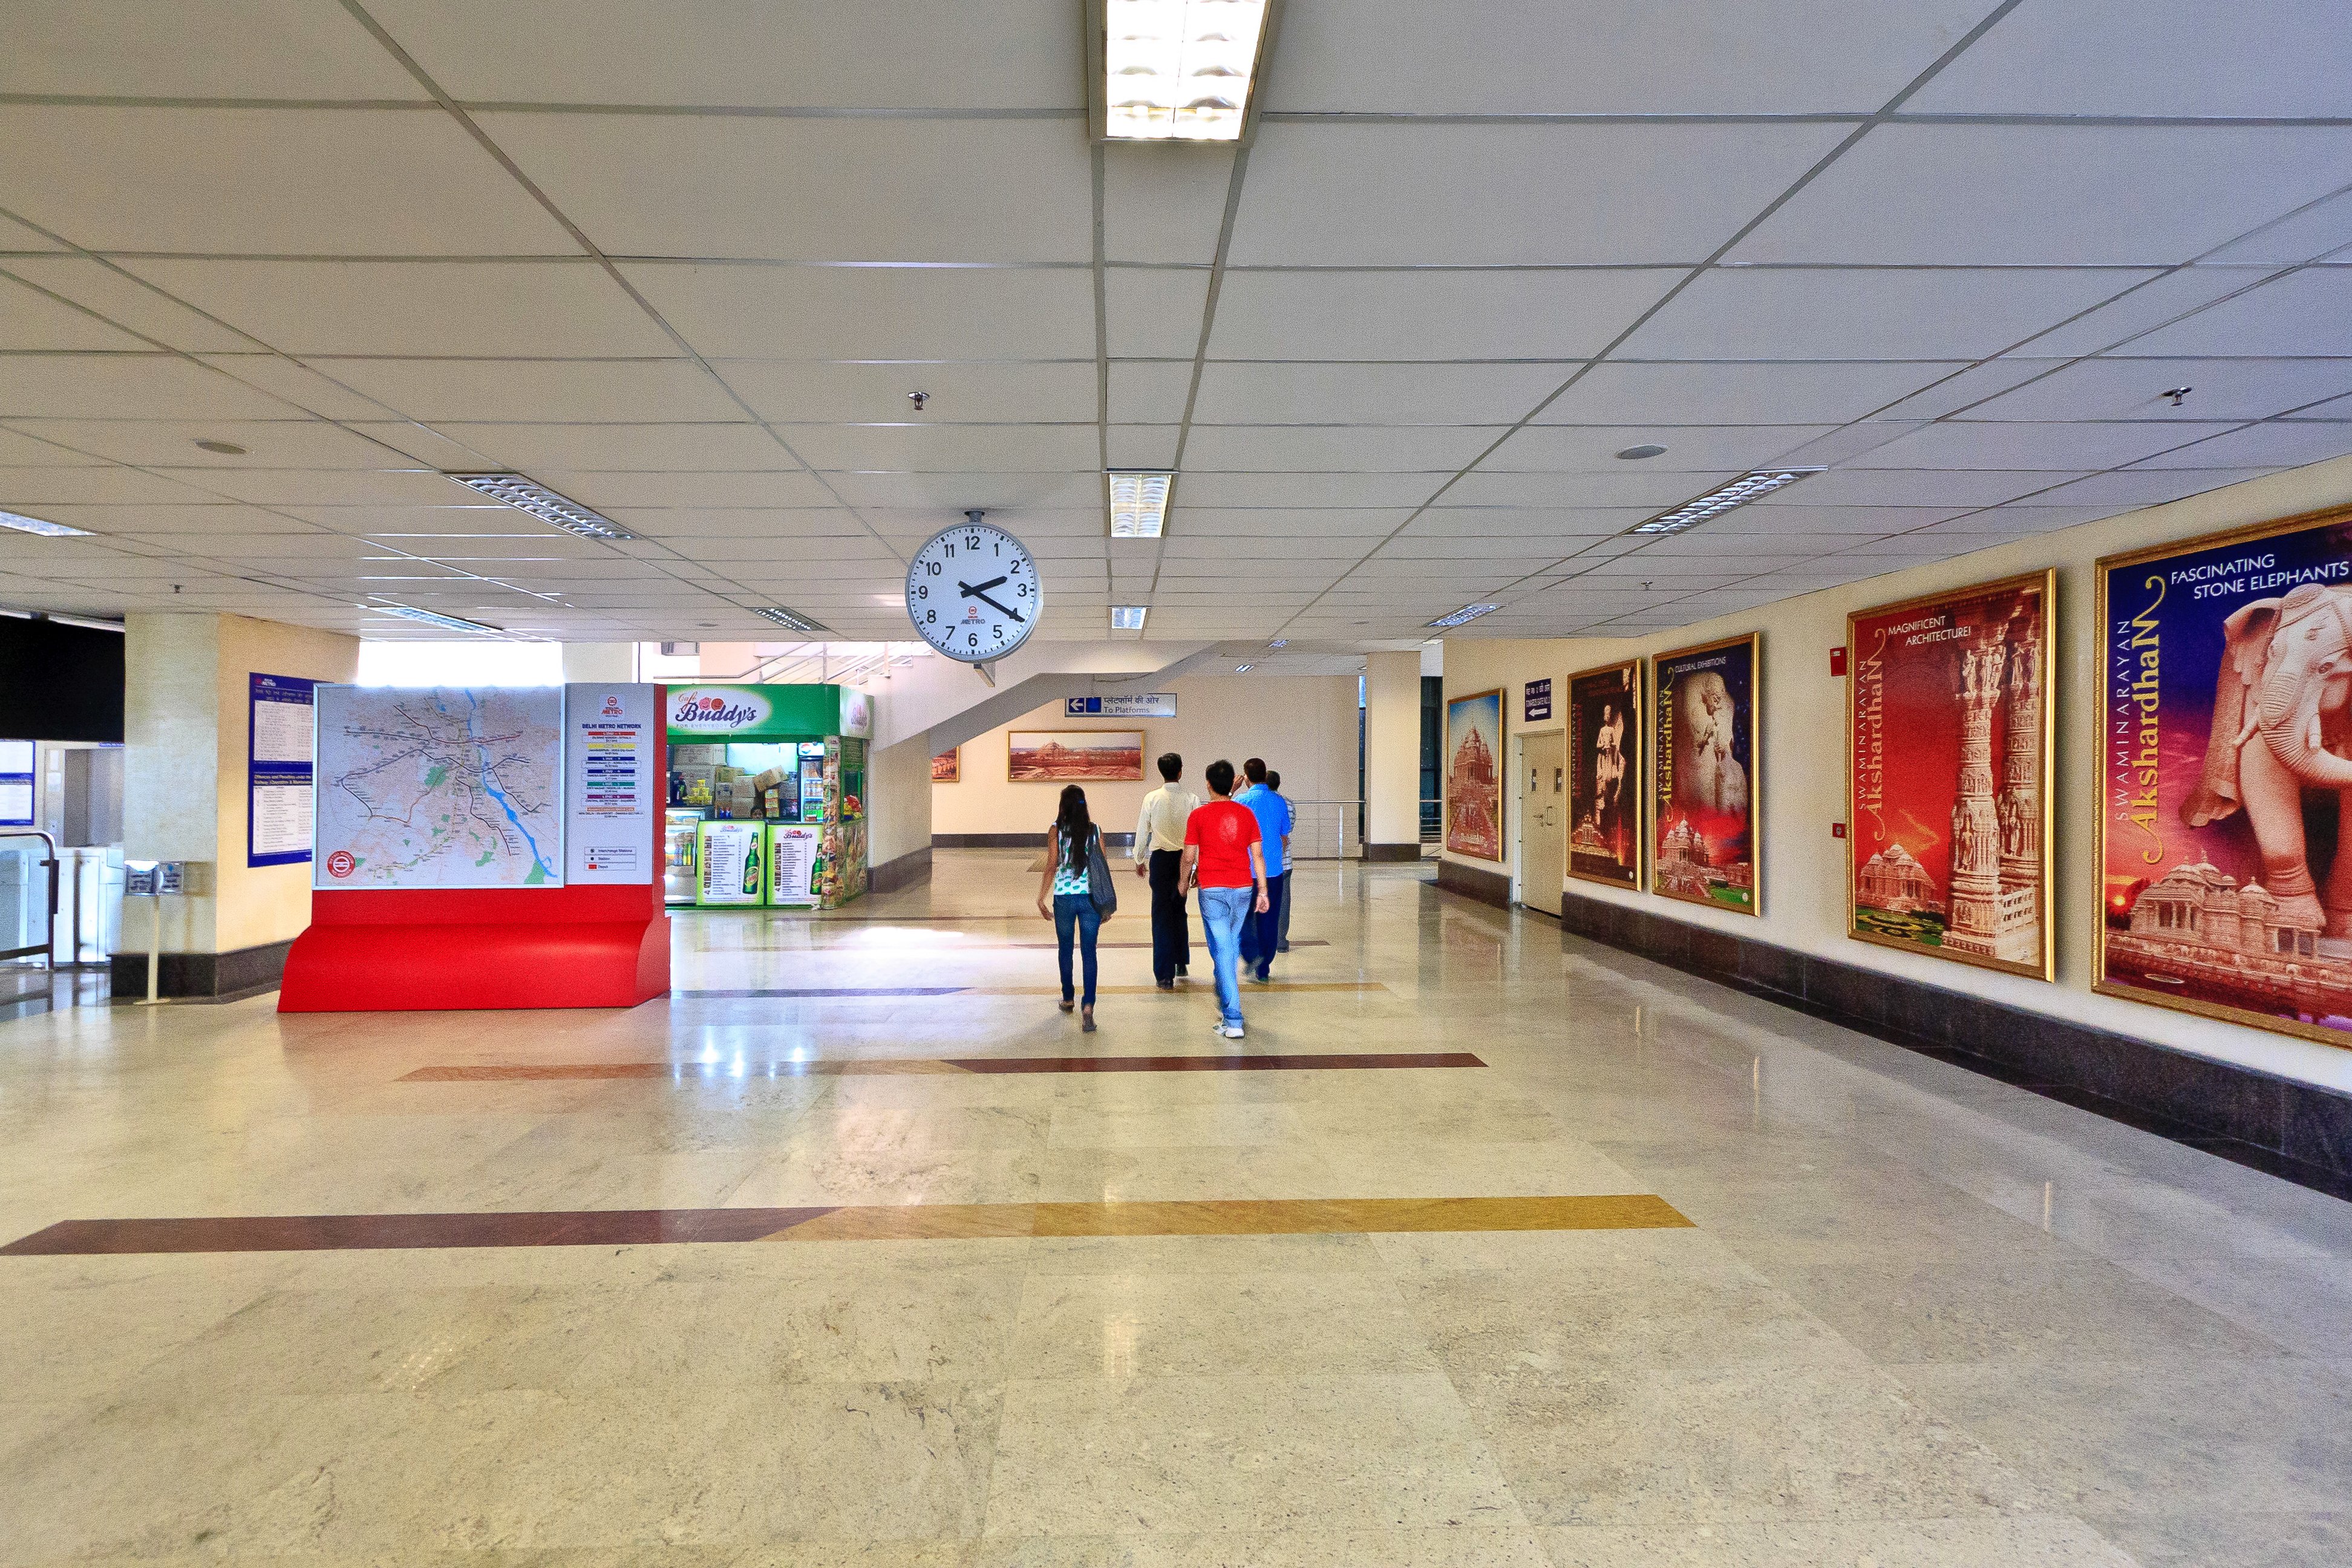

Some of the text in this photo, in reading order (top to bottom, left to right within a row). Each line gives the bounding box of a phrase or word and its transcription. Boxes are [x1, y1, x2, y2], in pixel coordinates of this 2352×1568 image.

[965, 536, 980, 550] 12
[994, 543, 999, 557] 1
[944, 544, 955, 558] 11
[926, 562, 941, 576] 10
[1010, 560, 1020, 573] 2
[2171, 554, 2275, 584] FASCINATING
[2194, 561, 2349, 599] STONE ELEPHANTS
[918, 586, 928, 599] 9
[1017, 583, 1027, 597] 3
[927, 610, 936, 623] 8
[993, 625, 1002, 639] 5
[1888, 616, 1945, 635] MAGNIFICENT
[946, 626, 955, 640] 7
[968, 633, 978, 647] 6
[1906, 626, 1971, 646] ARCHITECTURE!
[1675, 663, 1696, 673] CULTURAL
[1146, 695, 1159, 704] ओर
[675, 702, 756, 728] Buddy's
[2115, 619, 2130, 821] SWAMINARAYAN
[1858, 661, 1867, 809] SWAMINARAYAN
[783, 831, 812, 841] Buddy's
